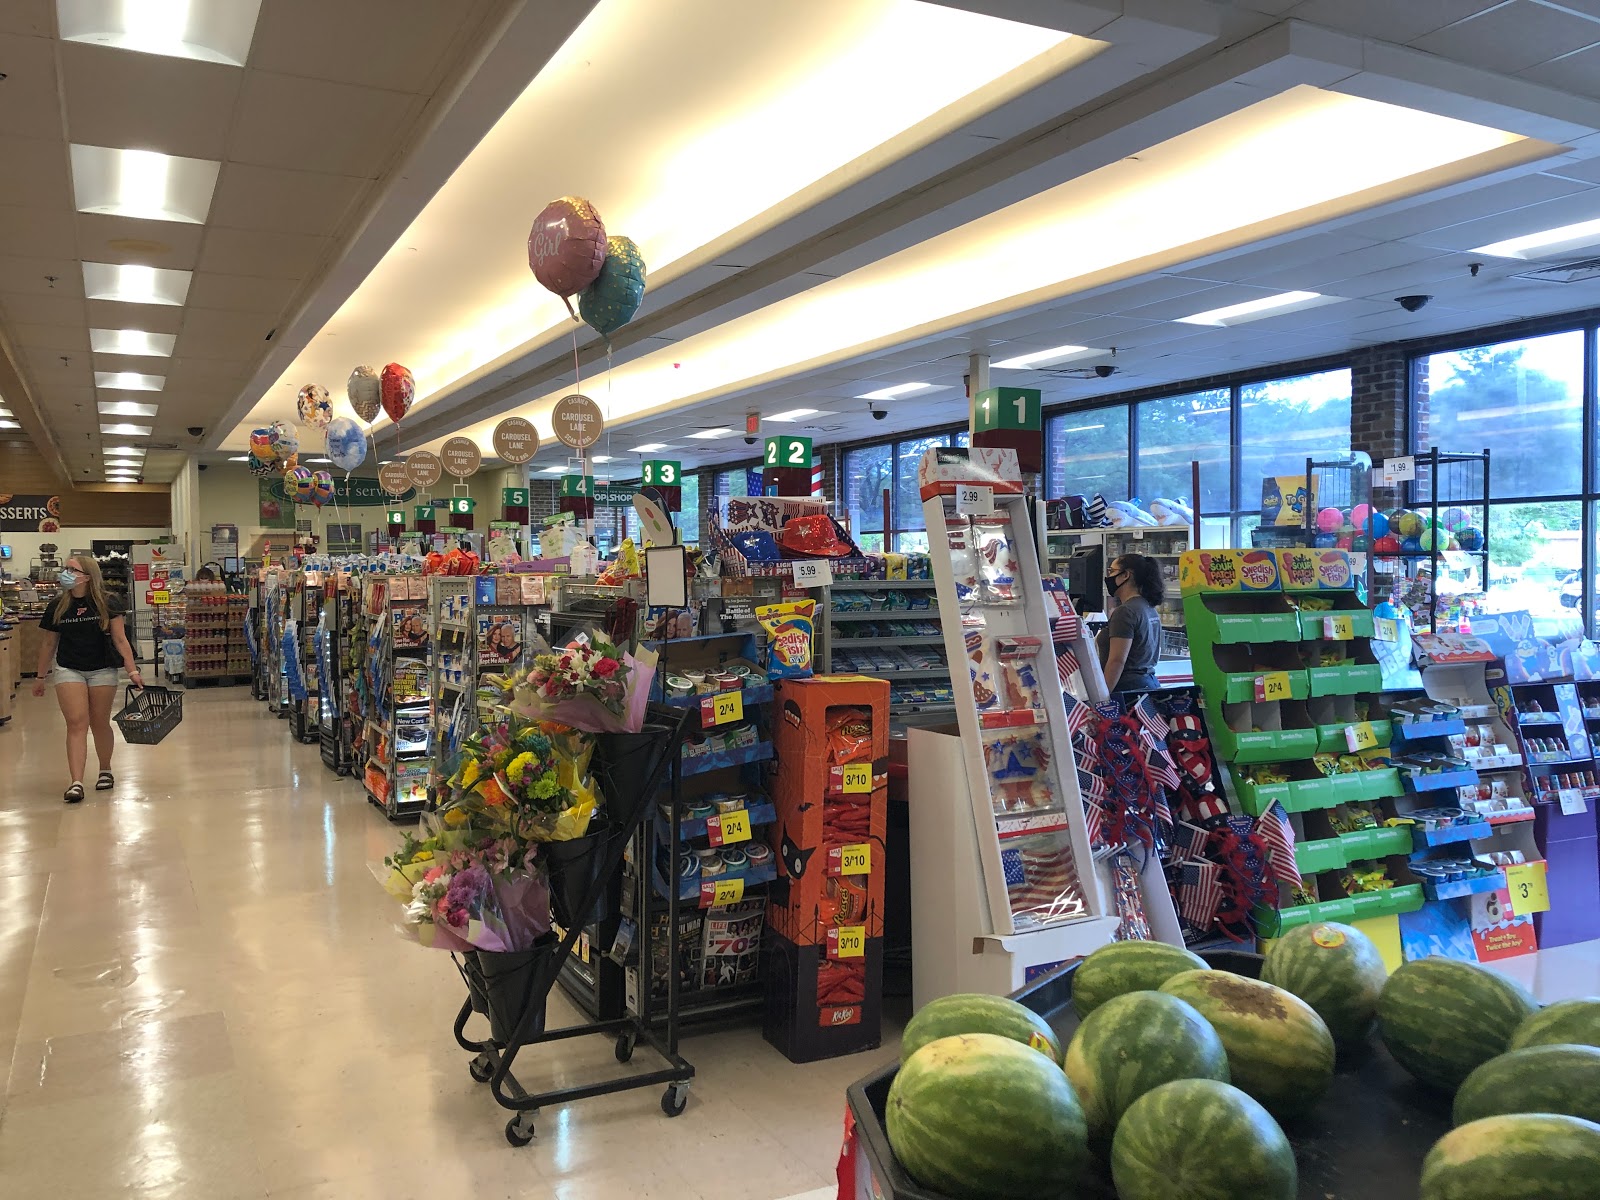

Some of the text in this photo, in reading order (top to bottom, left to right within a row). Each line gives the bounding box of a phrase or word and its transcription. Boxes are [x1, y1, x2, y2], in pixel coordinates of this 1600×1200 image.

[534, 232, 562, 266] Girl
[568, 398, 589, 406] CASHIER
[981, 396, 990, 425] 1
[1013, 396, 1026, 424] 1
[561, 412, 594, 422] CAROUSEL
[506, 420, 526, 428] CASHIER
[570, 423, 586, 432] LANE
[501, 432, 532, 441] CAROUSEL
[508, 442, 524, 450] LANE
[448, 450, 474, 458] CAROUSEL
[504, 450, 515, 460] SCAN
[520, 452, 529, 460] BAG
[767, 441, 776, 464] 2
[788, 441, 804, 464] 2
[644, 464, 652, 482] 3
[660, 464, 674, 482] 3
[562, 480, 568, 493] 4
[576, 480, 586, 494] 4
[513, 492, 524, 504] 5
[610, 494, 632, 502] SHOP
[458, 500, 468, 512] 6
[393, 512, 402, 522] 8
[422, 508, 430, 518] 7
[1210, 562, 1234, 572] SOUR
[1293, 561, 1312, 570] SOUR
[1318, 564, 1346, 576] Swedish
[1211, 570, 1236, 579] PATCH
[1241, 564, 1274, 578] Swedish
[1293, 570, 1314, 578] PATCH
[1250, 573, 1269, 584] Fish
[1327, 572, 1344, 582] Fish
[711, 922, 727, 930] LIFE
[1486, 944, 1501, 952] Twice
